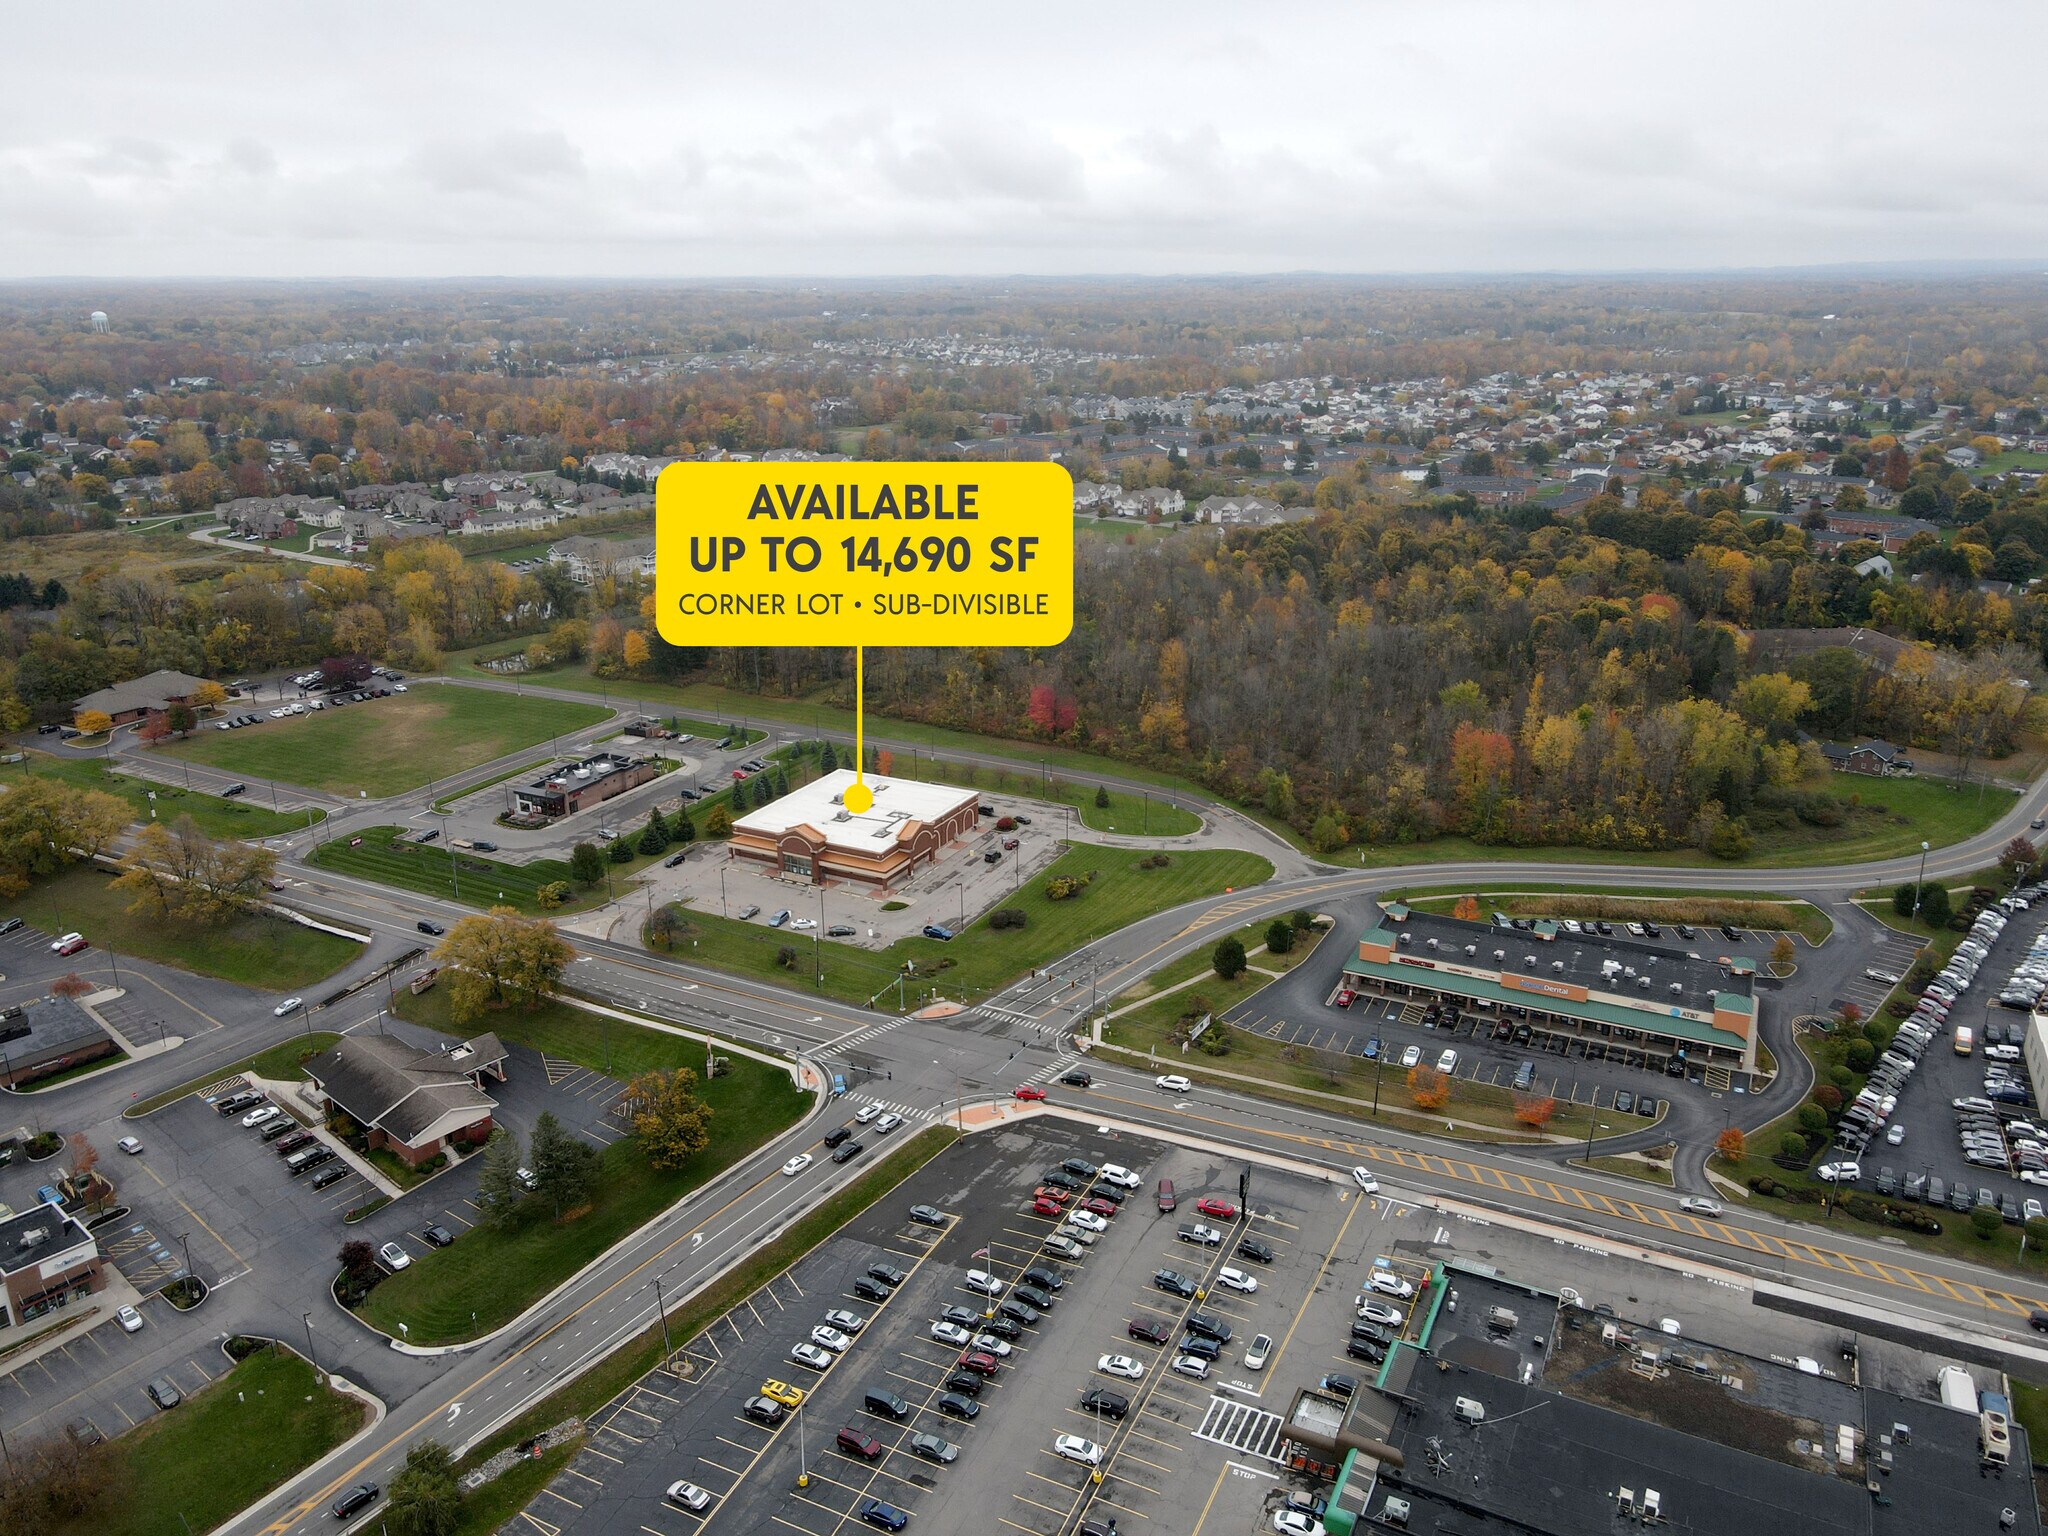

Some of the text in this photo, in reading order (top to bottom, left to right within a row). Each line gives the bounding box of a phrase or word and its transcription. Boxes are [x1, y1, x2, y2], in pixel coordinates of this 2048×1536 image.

[1681, 1011, 1700, 1020] AT&T
[1456, 1214, 1490, 1226] PARKING
[1573, 1243, 1609, 1257] PARKING
[1682, 1271, 1745, 1292] NO PARKING
[1823, 1368, 1837, 1377] NO
[1231, 1380, 1254, 1390] STOP
[1232, 1468, 1257, 1480] STOP
